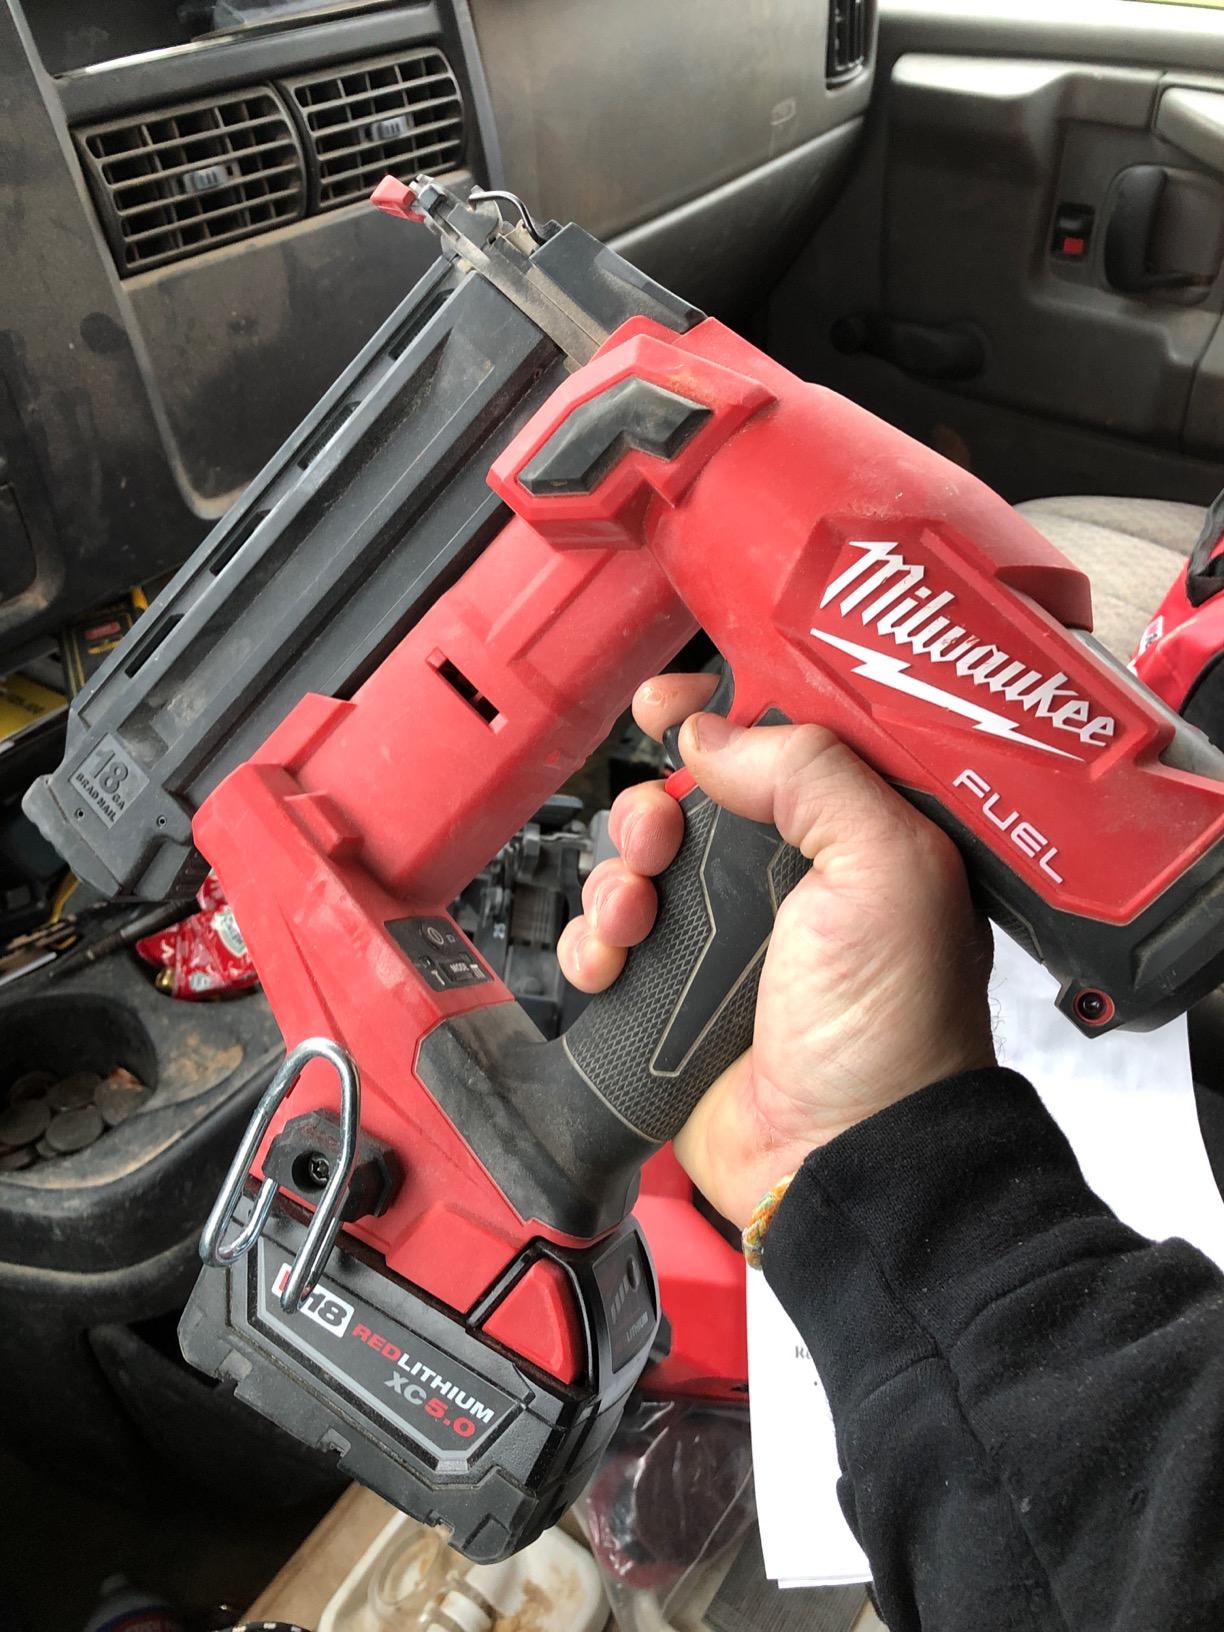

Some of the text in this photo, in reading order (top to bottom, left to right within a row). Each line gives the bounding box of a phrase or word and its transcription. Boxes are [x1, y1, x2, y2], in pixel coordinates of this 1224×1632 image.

[820, 541, 1116, 747] Milwaukee
[76, 773, 117, 821] BRAD NAIL
[90, 749, 129, 810] 18 GA
[952, 768, 1064, 885] FUEL
[384, 1370, 476, 1438] XC5.0
